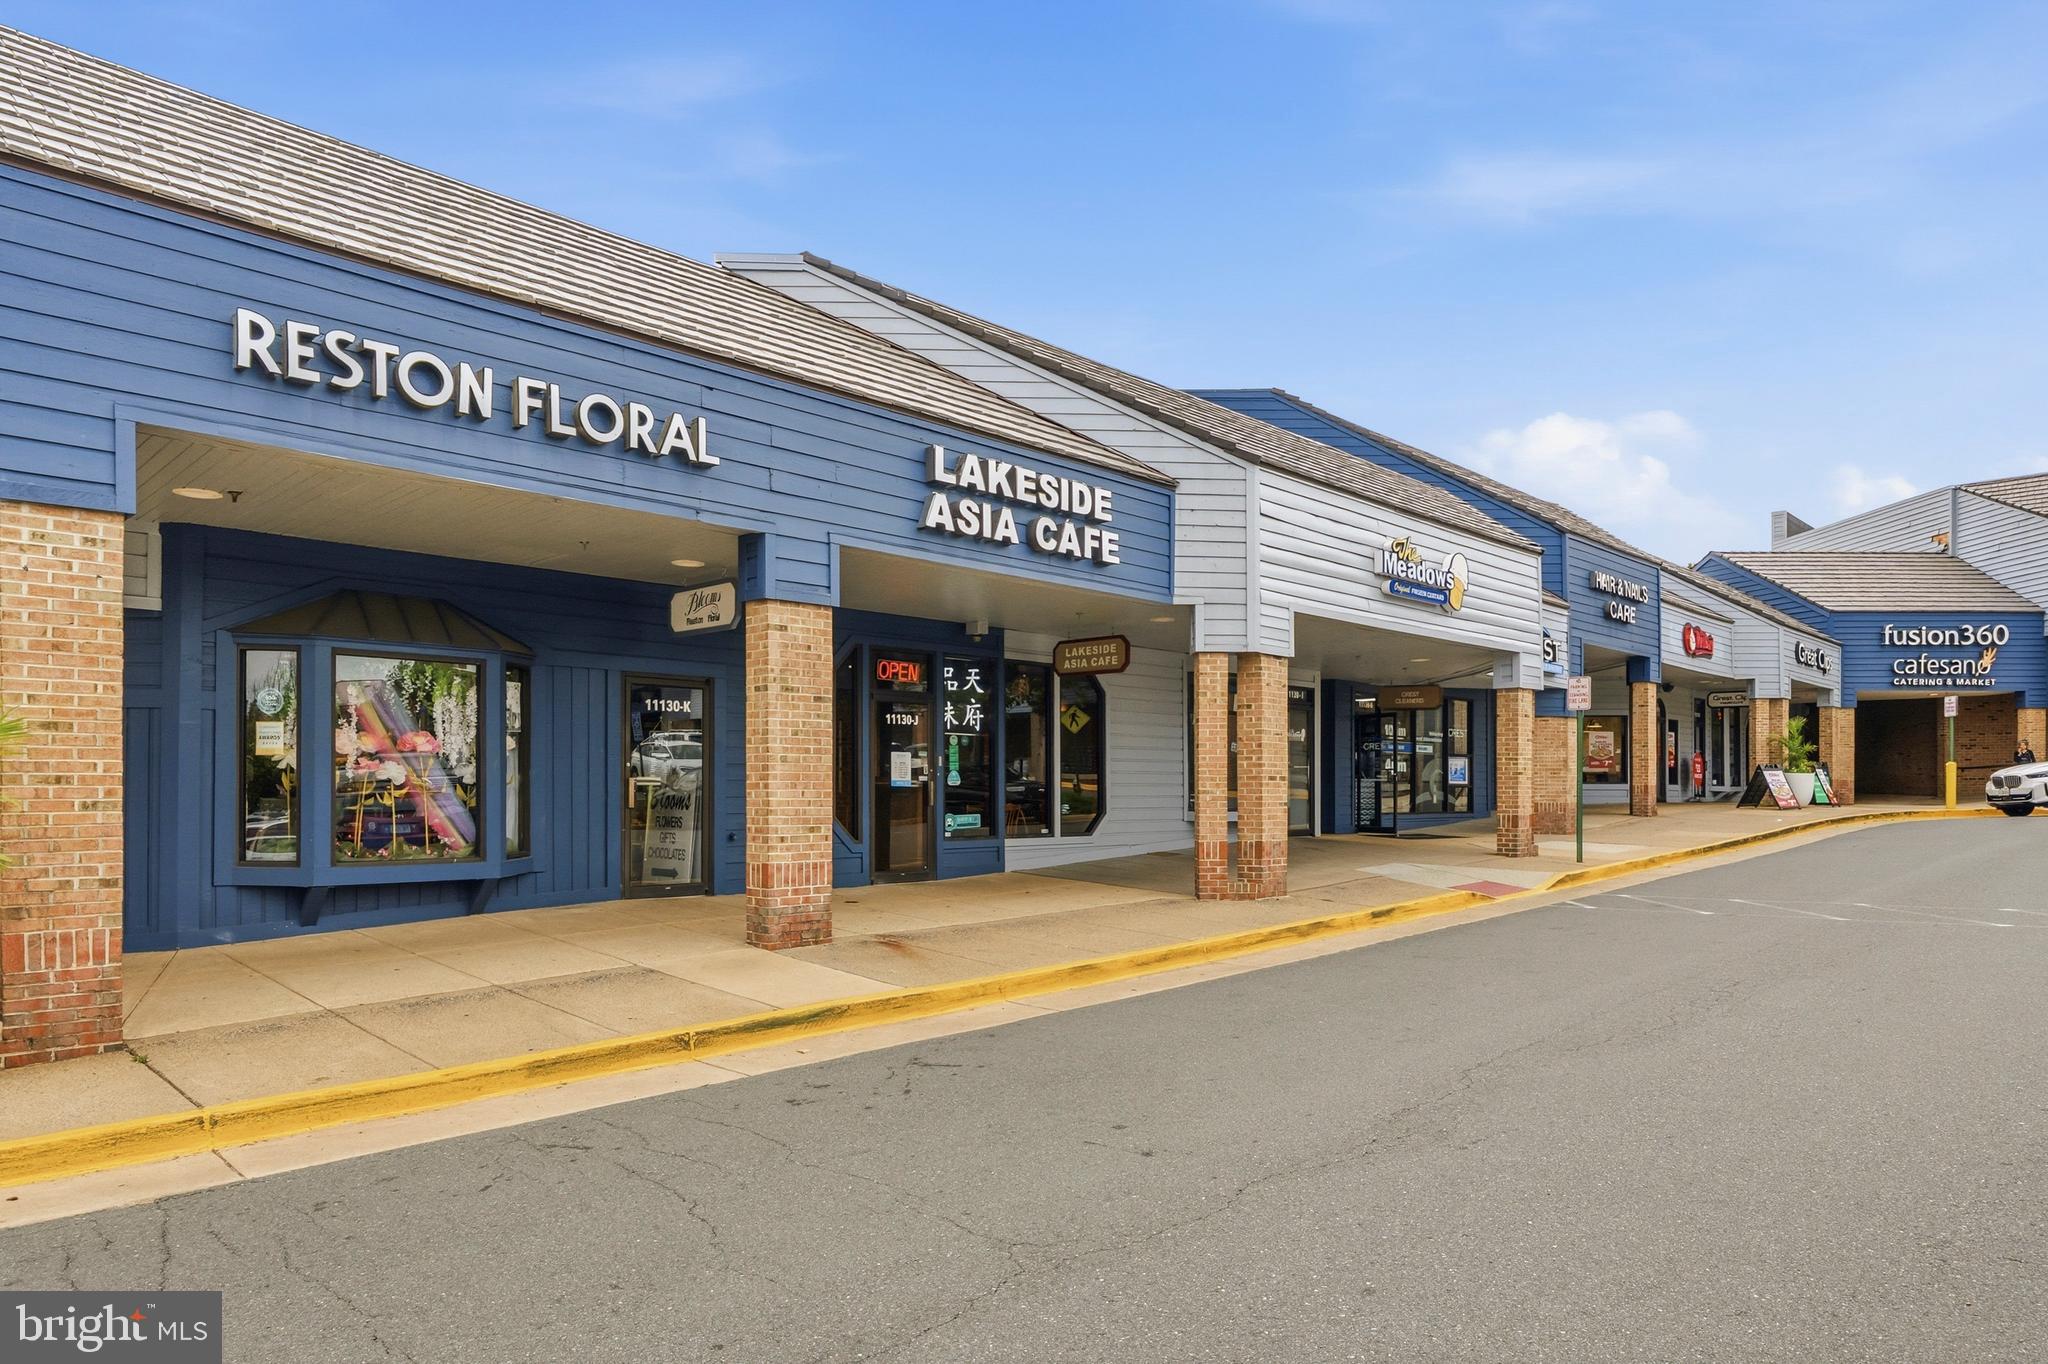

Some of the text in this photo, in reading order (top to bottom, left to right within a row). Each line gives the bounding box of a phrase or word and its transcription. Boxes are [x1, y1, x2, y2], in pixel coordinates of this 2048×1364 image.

[234, 307, 720, 467] RESTON FLORAL
[929, 444, 1114, 523] LAKESIDE
[924, 492, 1121, 565] ASIA CAFE
[1392, 536, 1422, 562] The
[1383, 550, 1455, 590] Meadows
[1595, 570, 1649, 604] HAIR & NAILS
[1610, 601, 1636, 624] CARE
[1883, 624, 2010, 646] fusion360
[1065, 643, 1117, 657] LAKESIDE
[1798, 643, 1818, 666] Great
[879, 661, 919, 682] OPEN
[1063, 656, 1118, 669] ASIA CAFE
[1893, 653, 1992, 676] cafesano
[1893, 678, 1997, 686] CATERING & MARKET
[645, 699, 691, 712] 11130-K
[963, 668, 984, 732] 天府
[886, 713, 919, 726] 11130-J
[655, 816, 684, 829] FLOWERS
[659, 832, 677, 845] GIFTS
[648, 849, 686, 862] CHOCOLATES
